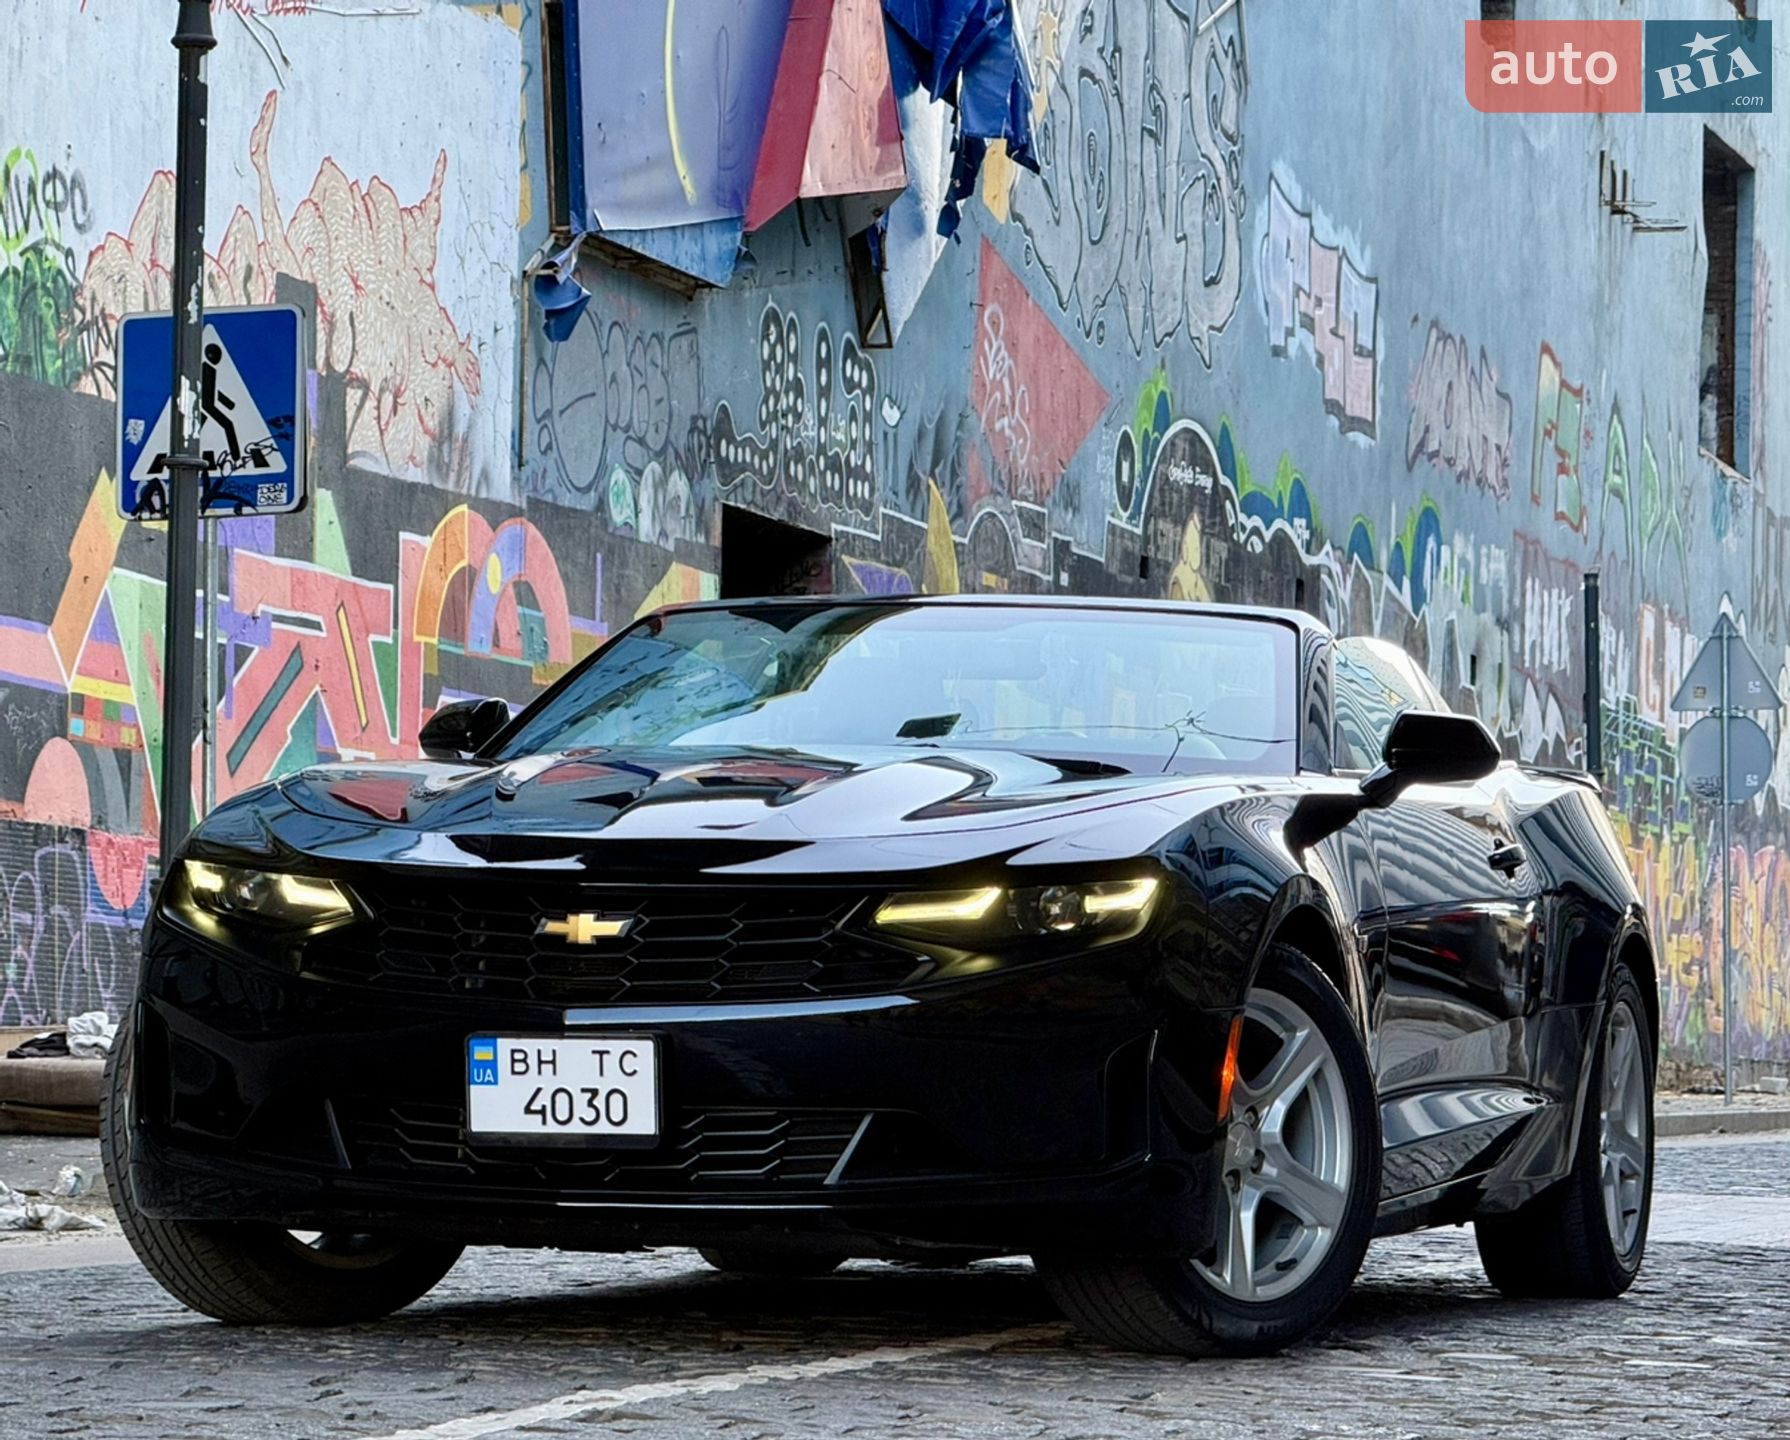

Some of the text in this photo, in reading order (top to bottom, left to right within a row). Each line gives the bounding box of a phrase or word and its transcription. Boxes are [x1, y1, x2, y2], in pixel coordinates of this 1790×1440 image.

[473, 1068, 495, 1083] UA
[510, 1048, 639, 1078] BH TC
[523, 1086, 629, 1127] 4030
